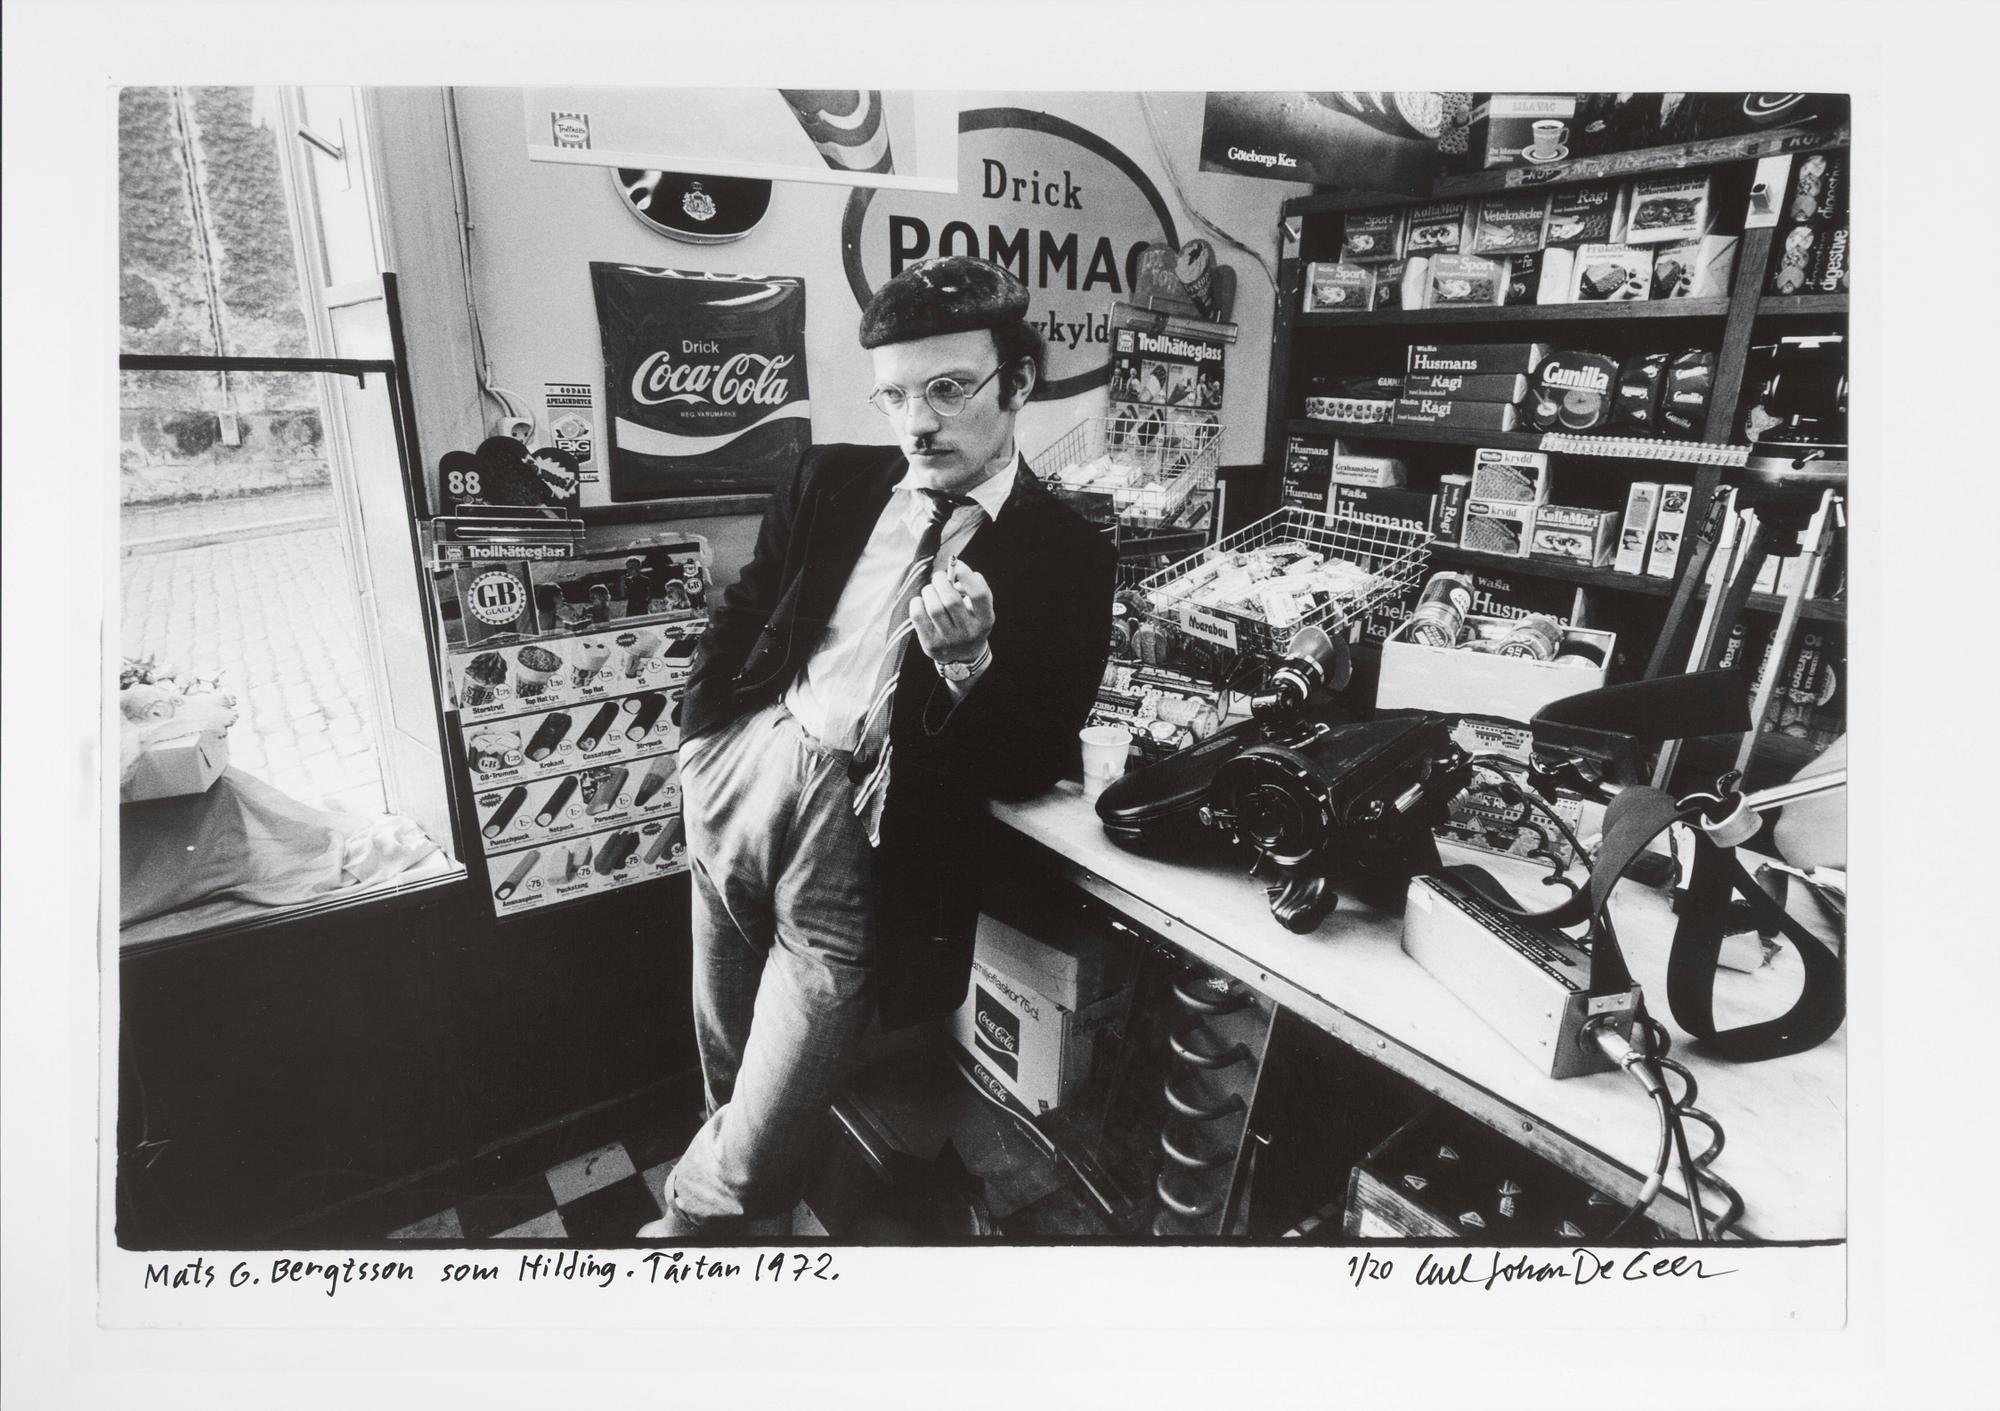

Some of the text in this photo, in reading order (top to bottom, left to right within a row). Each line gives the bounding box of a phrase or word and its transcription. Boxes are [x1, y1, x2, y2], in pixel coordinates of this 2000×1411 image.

[1227, 146, 1297, 168] Göteborgs Kex
[982, 158, 1083, 210] Drick
[1483, 207, 1544, 222] Veteknäcke
[1459, 256, 1496, 273] Sport
[1820, 229, 1849, 291] digestive
[1335, 265, 1367, 281] Sport
[682, 339, 720, 354] Drick
[1137, 331, 1223, 362] Trollhätteglass
[1413, 354, 1478, 370] Husmans
[631, 350, 795, 406] Coca-Cola
[1542, 361, 1610, 391] Gunilla
[560, 387, 592, 395] GODARE
[557, 440, 590, 452] BIG
[1289, 442, 1329, 456] Husmans
[1503, 453, 1533, 464] krydd
[448, 470, 481, 495] 88
[1284, 485, 1323, 501] Husmans
[1338, 500, 1424, 533] Husmans
[1490, 505, 1517, 517] krydd
[467, 544, 566, 560] Trollhätteglass
[477, 581, 518, 608] GB
[485, 605, 514, 616] GLACE
[1378, 601, 1414, 621] hela
[1471, 590, 1569, 627] Husms
[1188, 614, 1229, 640] Marabou
[1365, 615, 1395, 638] kal
[1719, 638, 1741, 668] Brag
[582, 685, 604, 696] Top Hat
[472, 703, 505, 715] Storstrut
[524, 697, 536, 706] Top
[1116, 705, 1135, 717] KEX
[539, 759, 565, 769] Krokant
[480, 769, 519, 782] GB-Trumma
[643, 801, 672, 813] Super Jet
[977, 1009, 1017, 1051] Coca-Cola
[973, 1063, 1008, 1103] Coca-Cola
[144, 1257, 215, 1289] Mats
[229, 1261, 260, 1288] G.
[271, 1257, 415, 1298] Bengtsson
[441, 1264, 499, 1283] som
[642, 1251, 741, 1284] Tårtan
[754, 1252, 840, 1283] 1972.
[1347, 1251, 1394, 1287] 1/20
[1571, 1248, 1614, 1286] De
